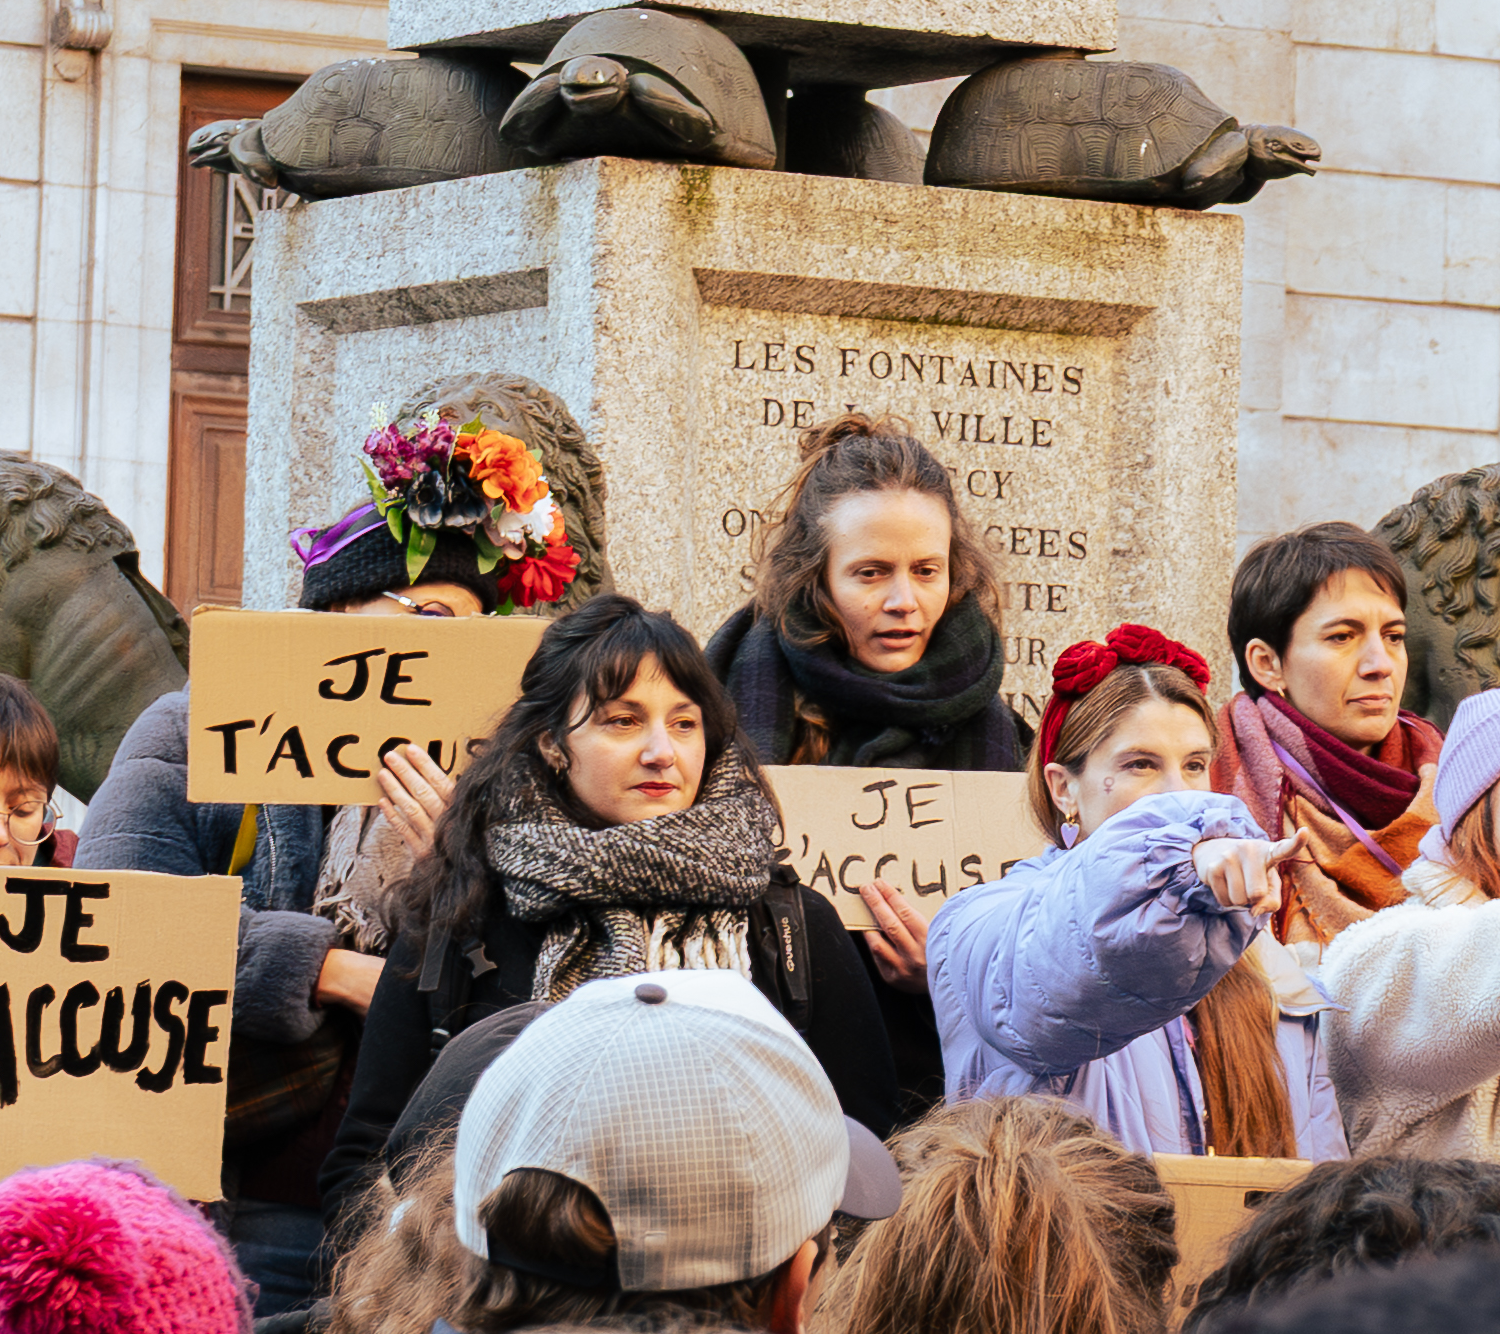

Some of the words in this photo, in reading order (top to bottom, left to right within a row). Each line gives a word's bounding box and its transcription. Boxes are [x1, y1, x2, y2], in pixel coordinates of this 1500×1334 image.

[731, 339, 817, 375] LES
[838, 347, 1085, 396] FONTAINES
[762, 397, 815, 429] DE
[930, 410, 1055, 449] VILLE
[318, 646, 433, 707] JE
[851, 778, 945, 830] JE
